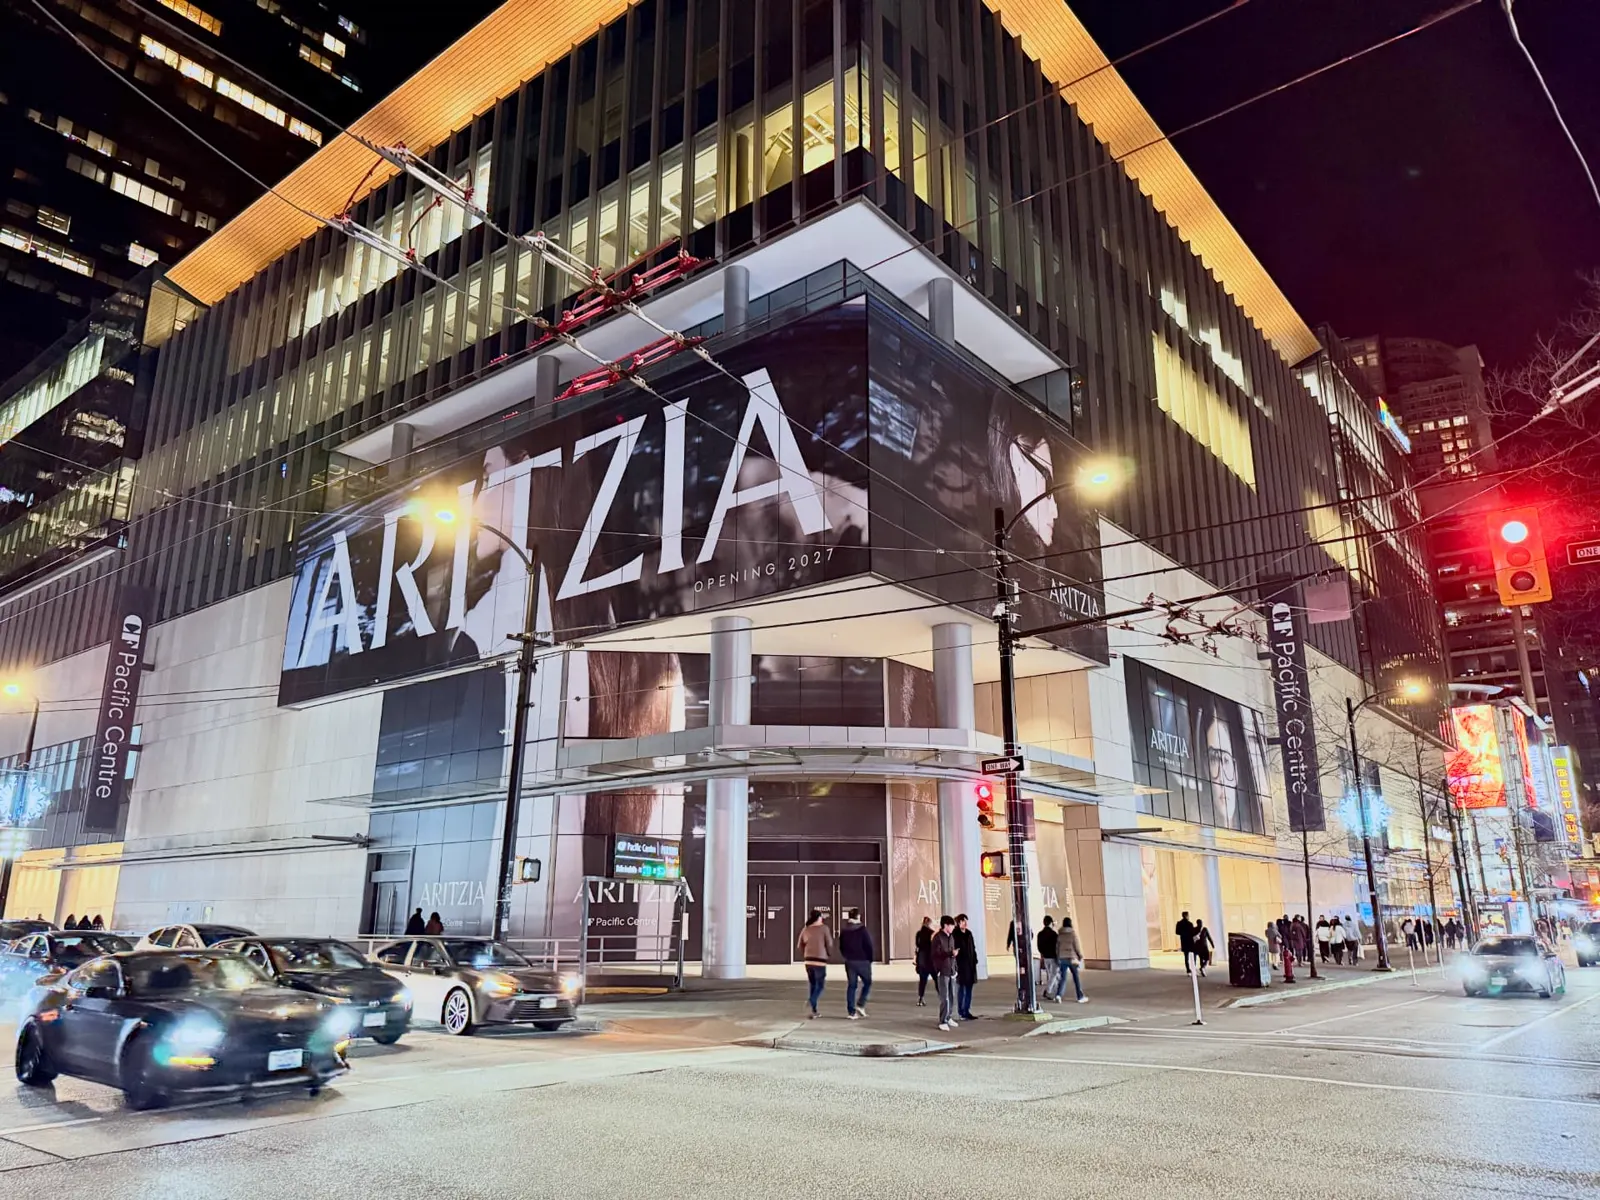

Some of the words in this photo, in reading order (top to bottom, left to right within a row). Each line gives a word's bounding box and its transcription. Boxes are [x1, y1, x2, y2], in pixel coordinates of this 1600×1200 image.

[295, 367, 832, 667] ARITZIA
[694, 562, 776, 593] OPENING
[788, 547, 834, 571] 2027
[1578, 547, 1599, 557] ONE
[1049, 578, 1100, 618] ARITZIA
[108, 651, 137, 720] Pacific
[1276, 640, 1301, 713] Pacific
[95, 726, 125, 799] Centre
[1150, 727, 1190, 759] ARITZIA
[1285, 718, 1308, 795] Centre
[1000, 761, 1011, 769] WAY
[1556, 768, 1572, 809] BEST
[419, 880, 485, 907] ARITZIA
[573, 876, 695, 904] ARITZIA
[595, 917, 625, 926] Pacific
[627, 916, 657, 926] Centre
